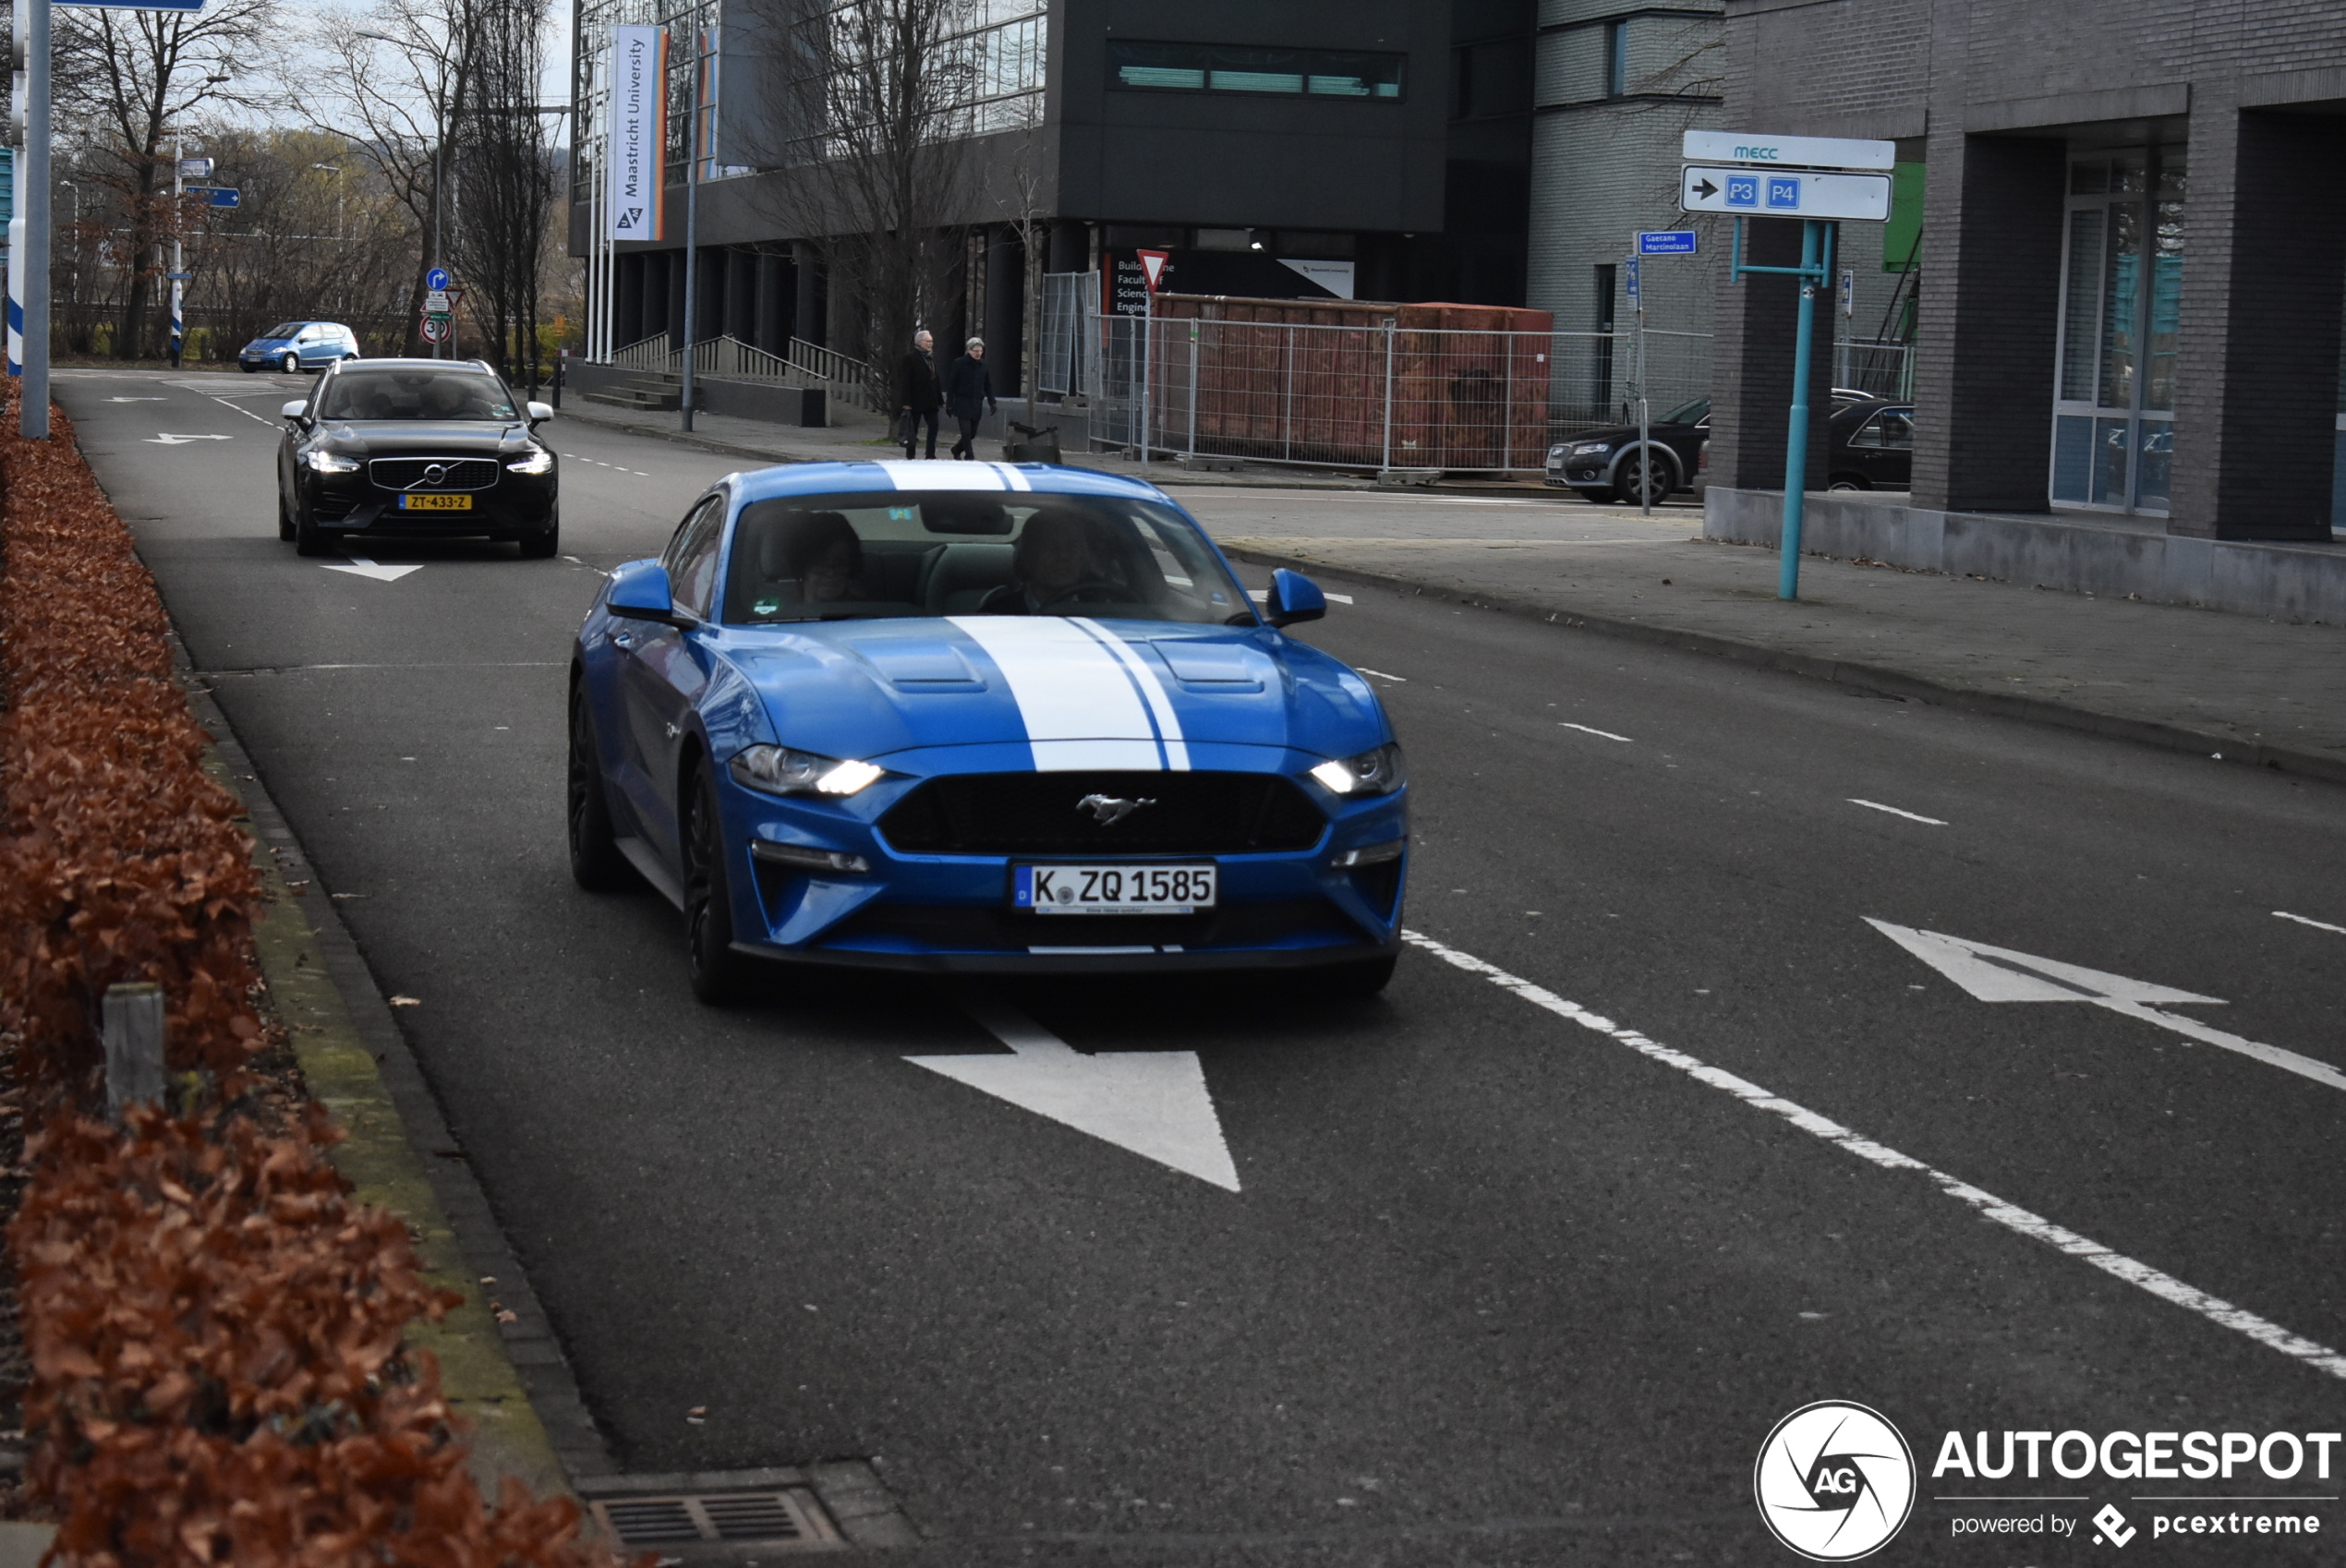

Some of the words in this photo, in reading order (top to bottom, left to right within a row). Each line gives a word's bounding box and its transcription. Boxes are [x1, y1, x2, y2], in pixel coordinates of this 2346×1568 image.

[627, 38, 646, 114] University
[624, 117, 639, 198] Maastricht
[1729, 183, 1752, 199] P3
[1772, 185, 1795, 201] P4
[1645, 243, 1689, 251] Martinolaan
[1119, 261, 1143, 271] Build
[1118, 274, 1146, 284] Facult
[1118, 288, 1147, 298] Scienc
[411, 496, 466, 508] ZT-433-Z
[1034, 870, 1056, 902] K
[1079, 871, 1122, 902] ZQ
[1130, 870, 1211, 902] 1585
